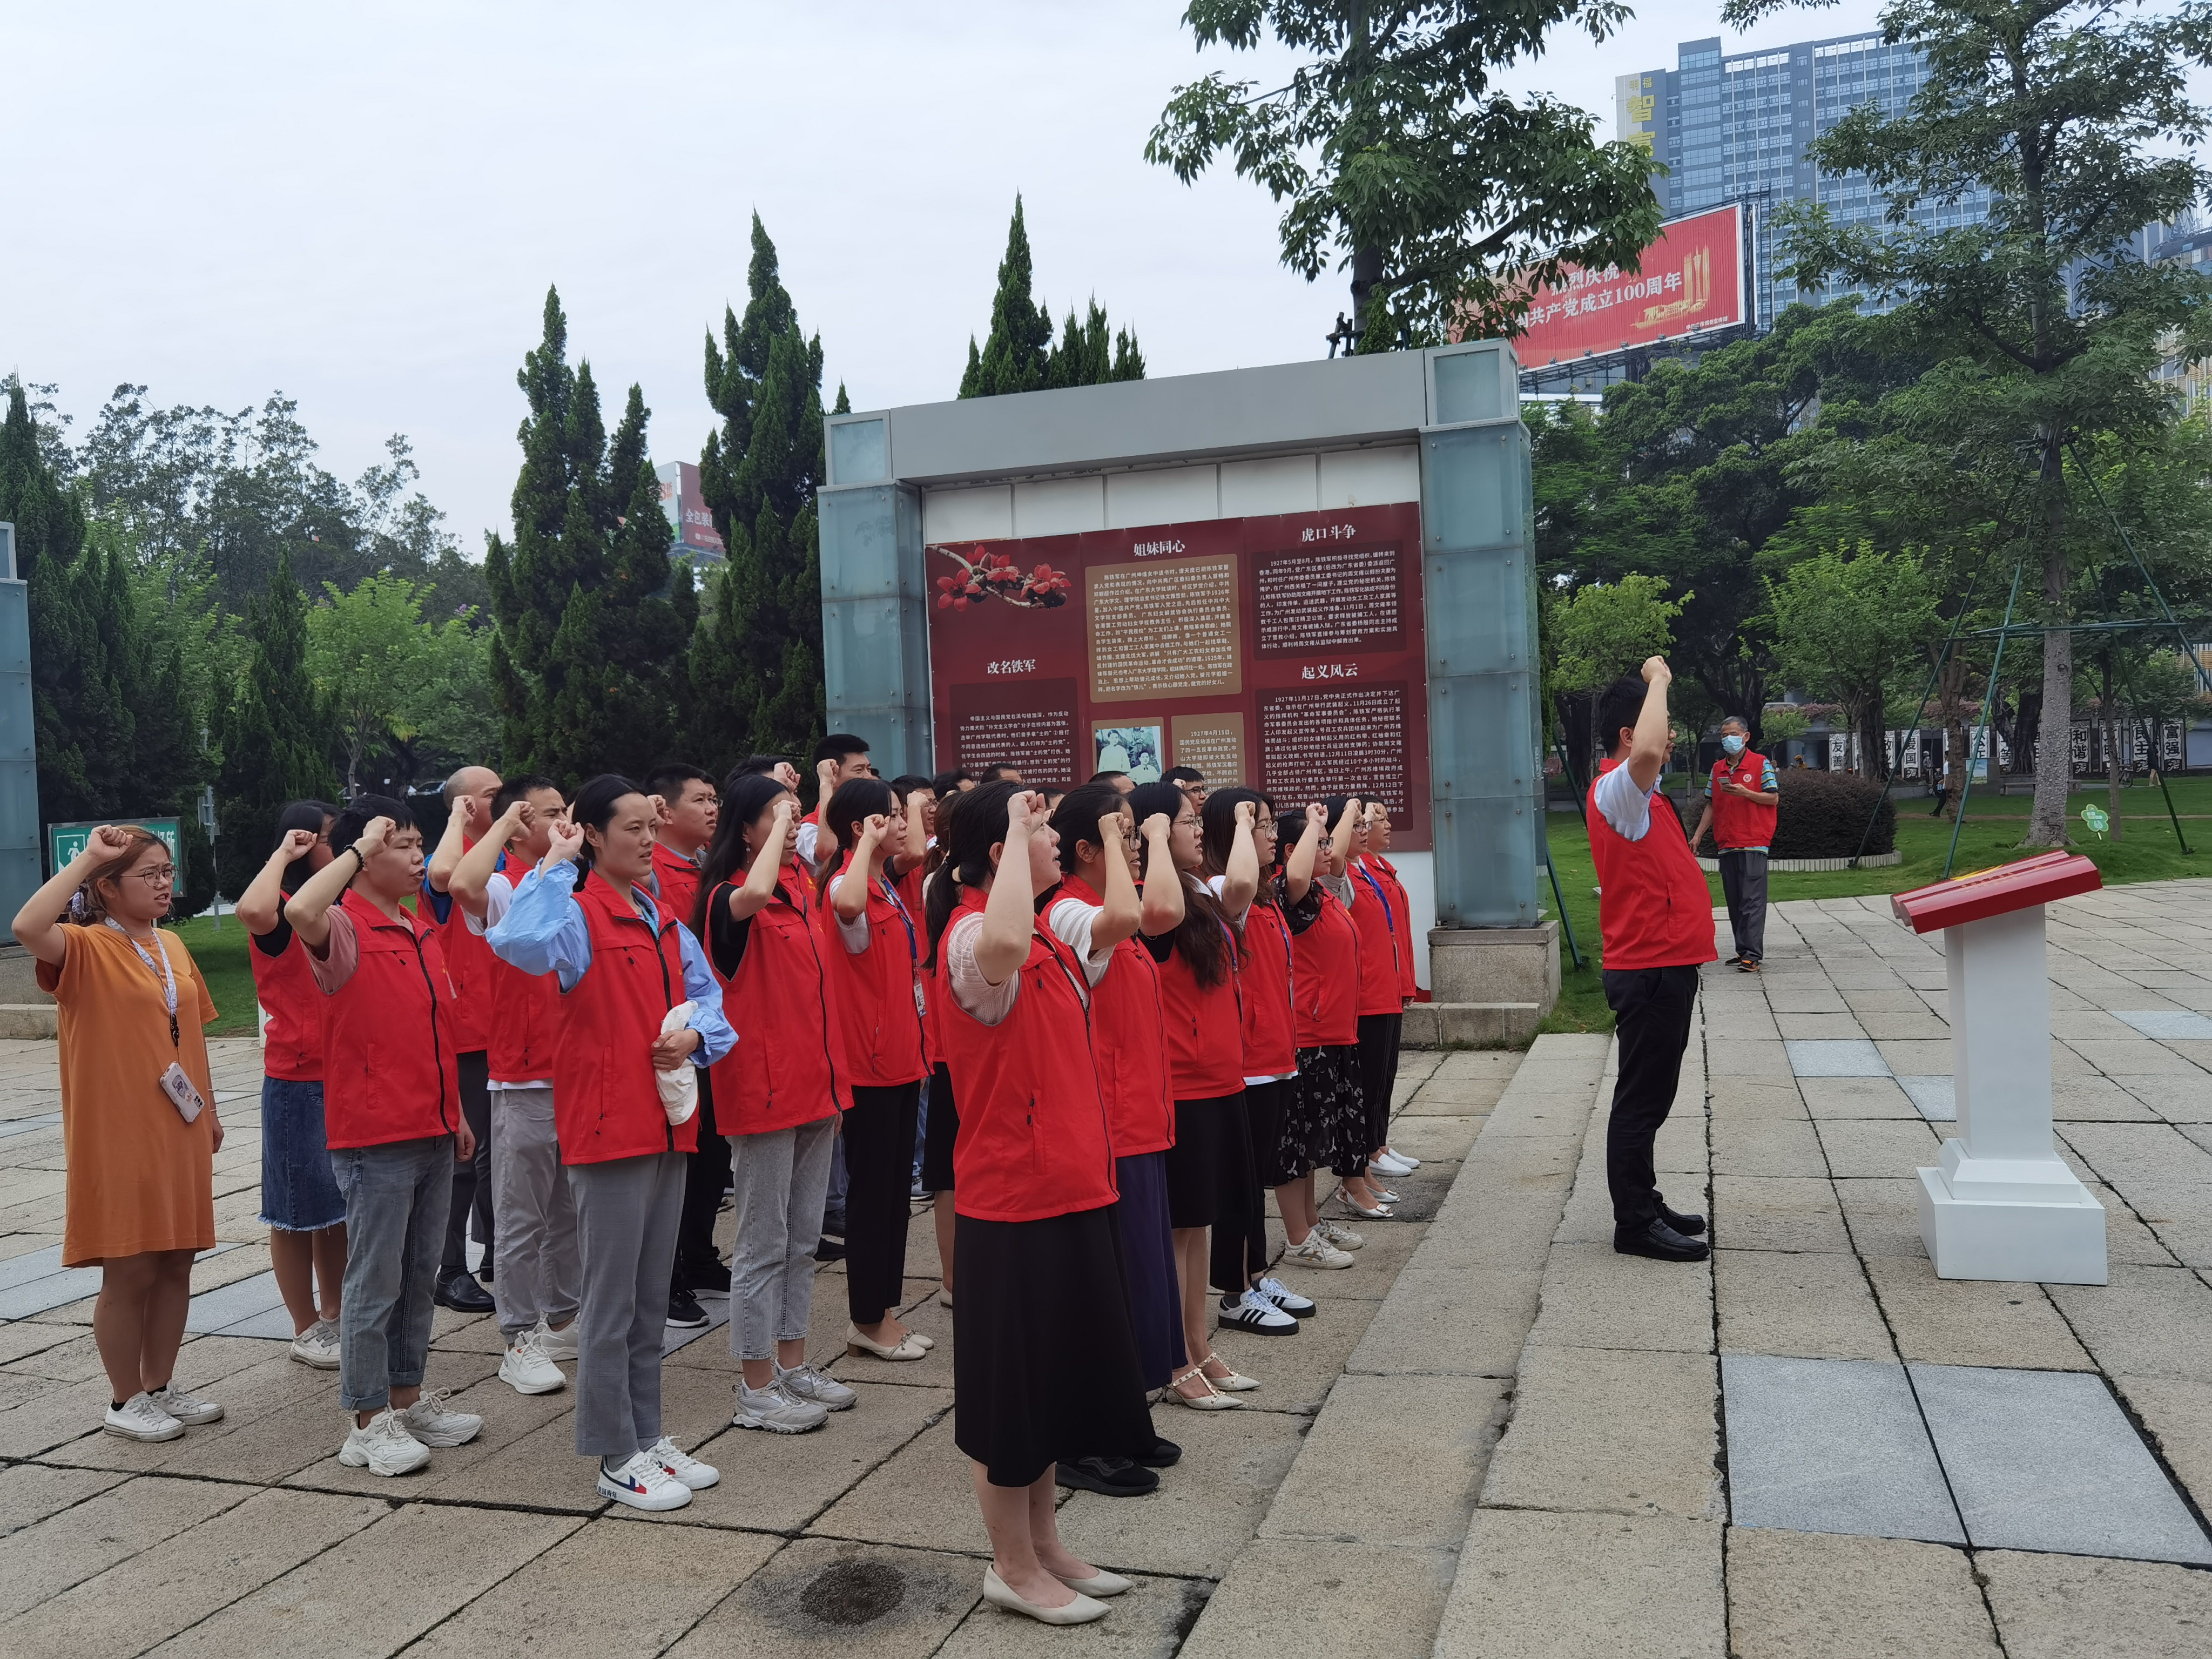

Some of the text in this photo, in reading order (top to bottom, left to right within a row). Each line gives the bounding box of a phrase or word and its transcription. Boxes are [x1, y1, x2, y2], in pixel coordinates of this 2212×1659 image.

[1499, 272, 1682, 331] 共产党成立100周年
[1301, 524, 1356, 542] 虎口斗争
[1134, 540, 1185, 556] 姐妹同心
[987, 659, 1036, 675] 改名铁军
[1301, 663, 1358, 680] 起义风云
[1179, 737, 1237, 745] 国民党反动派在广州发动
[1180, 745, 1237, 753] 了四一五反革命政变。中
[2073, 729, 2087, 759] 和谐
[2164, 725, 2180, 756] 富强
